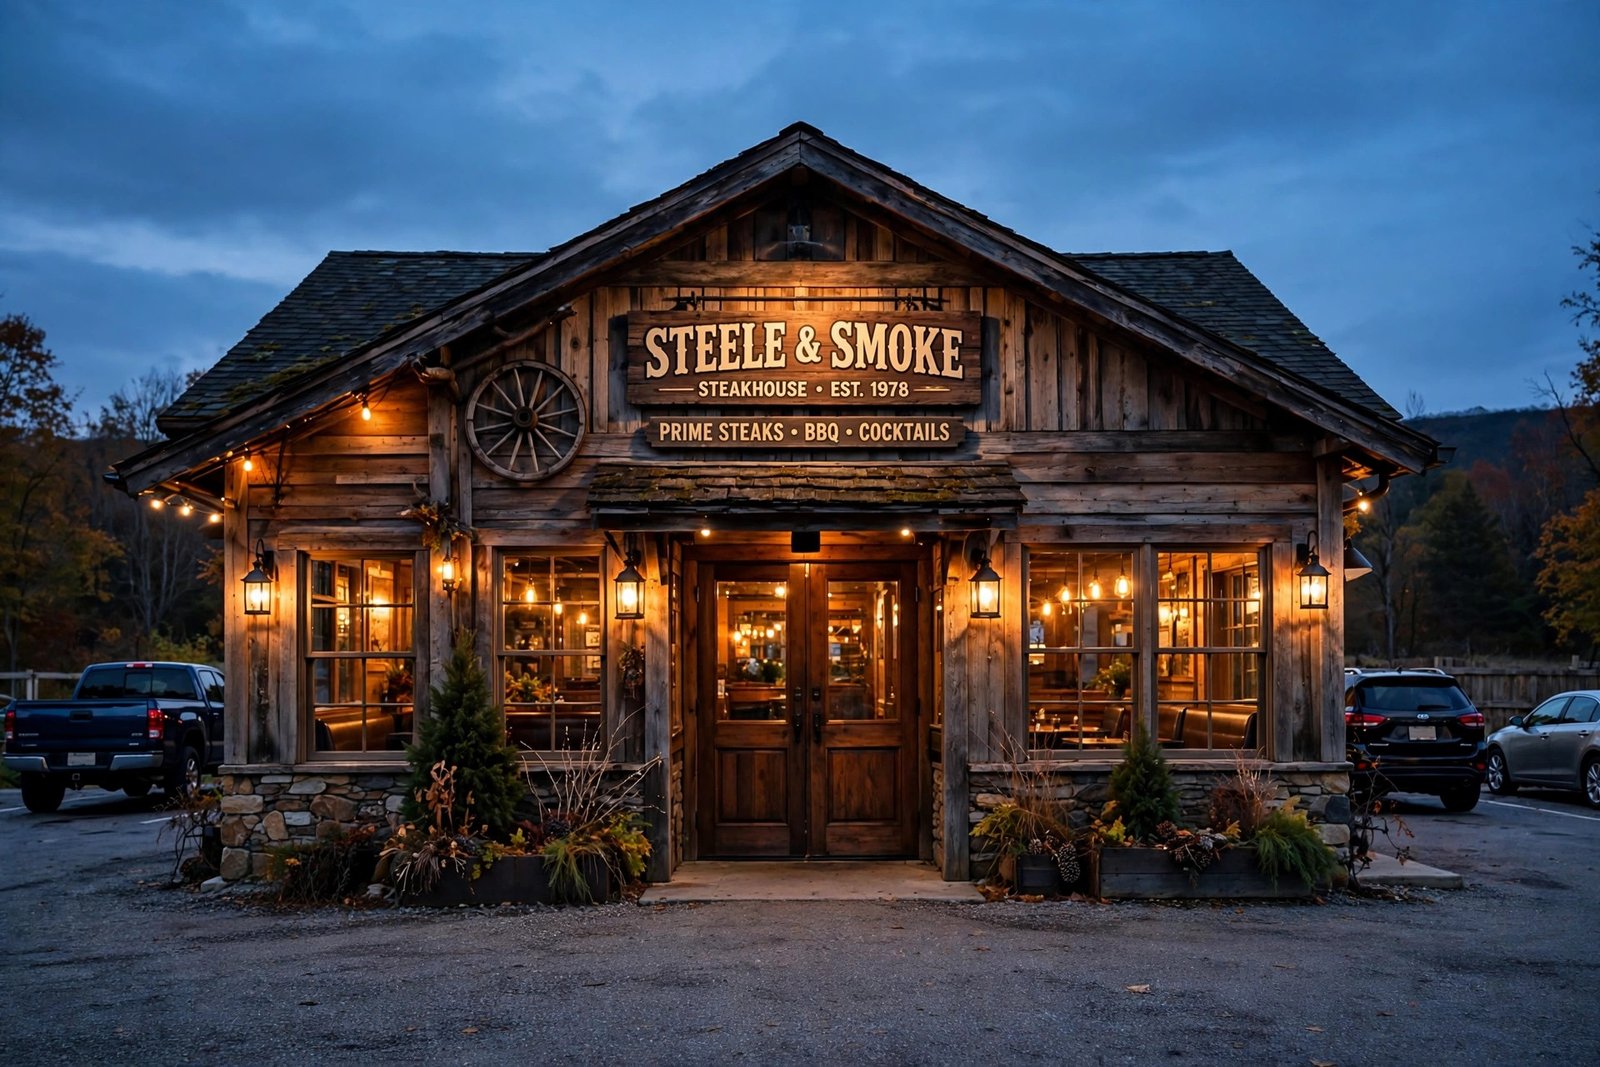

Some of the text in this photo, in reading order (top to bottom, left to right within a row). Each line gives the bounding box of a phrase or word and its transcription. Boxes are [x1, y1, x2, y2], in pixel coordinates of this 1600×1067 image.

[645, 320, 964, 379] STEELE & SMOKE
[698, 380, 909, 398] STEAKHOUSE EST. 1978
[659, 422, 950, 444] PRIME STEAKS BBQ COCKTAILS
